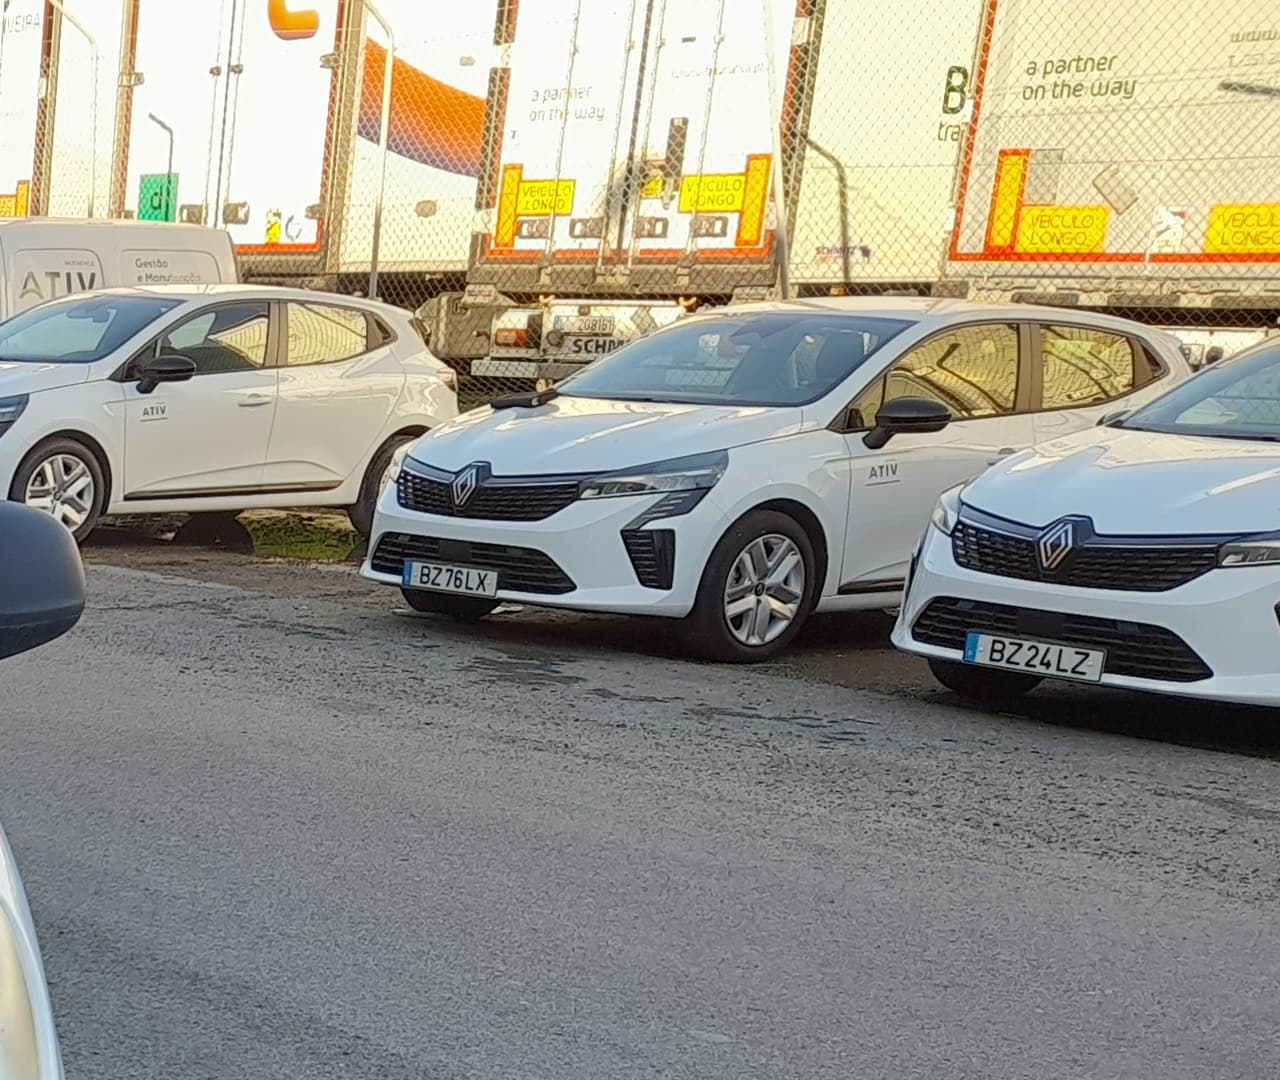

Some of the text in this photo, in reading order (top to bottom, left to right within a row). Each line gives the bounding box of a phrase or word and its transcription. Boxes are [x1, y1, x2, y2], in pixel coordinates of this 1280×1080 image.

[1026, 55, 1118, 78] a partner
[942, 66, 968, 114] B
[1023, 79, 1138, 100] on the way
[575, 106, 605, 121] way
[19, 271, 97, 299] ATIV
[143, 405, 167, 417] ATIV
[869, 463, 898, 480] ATIV
